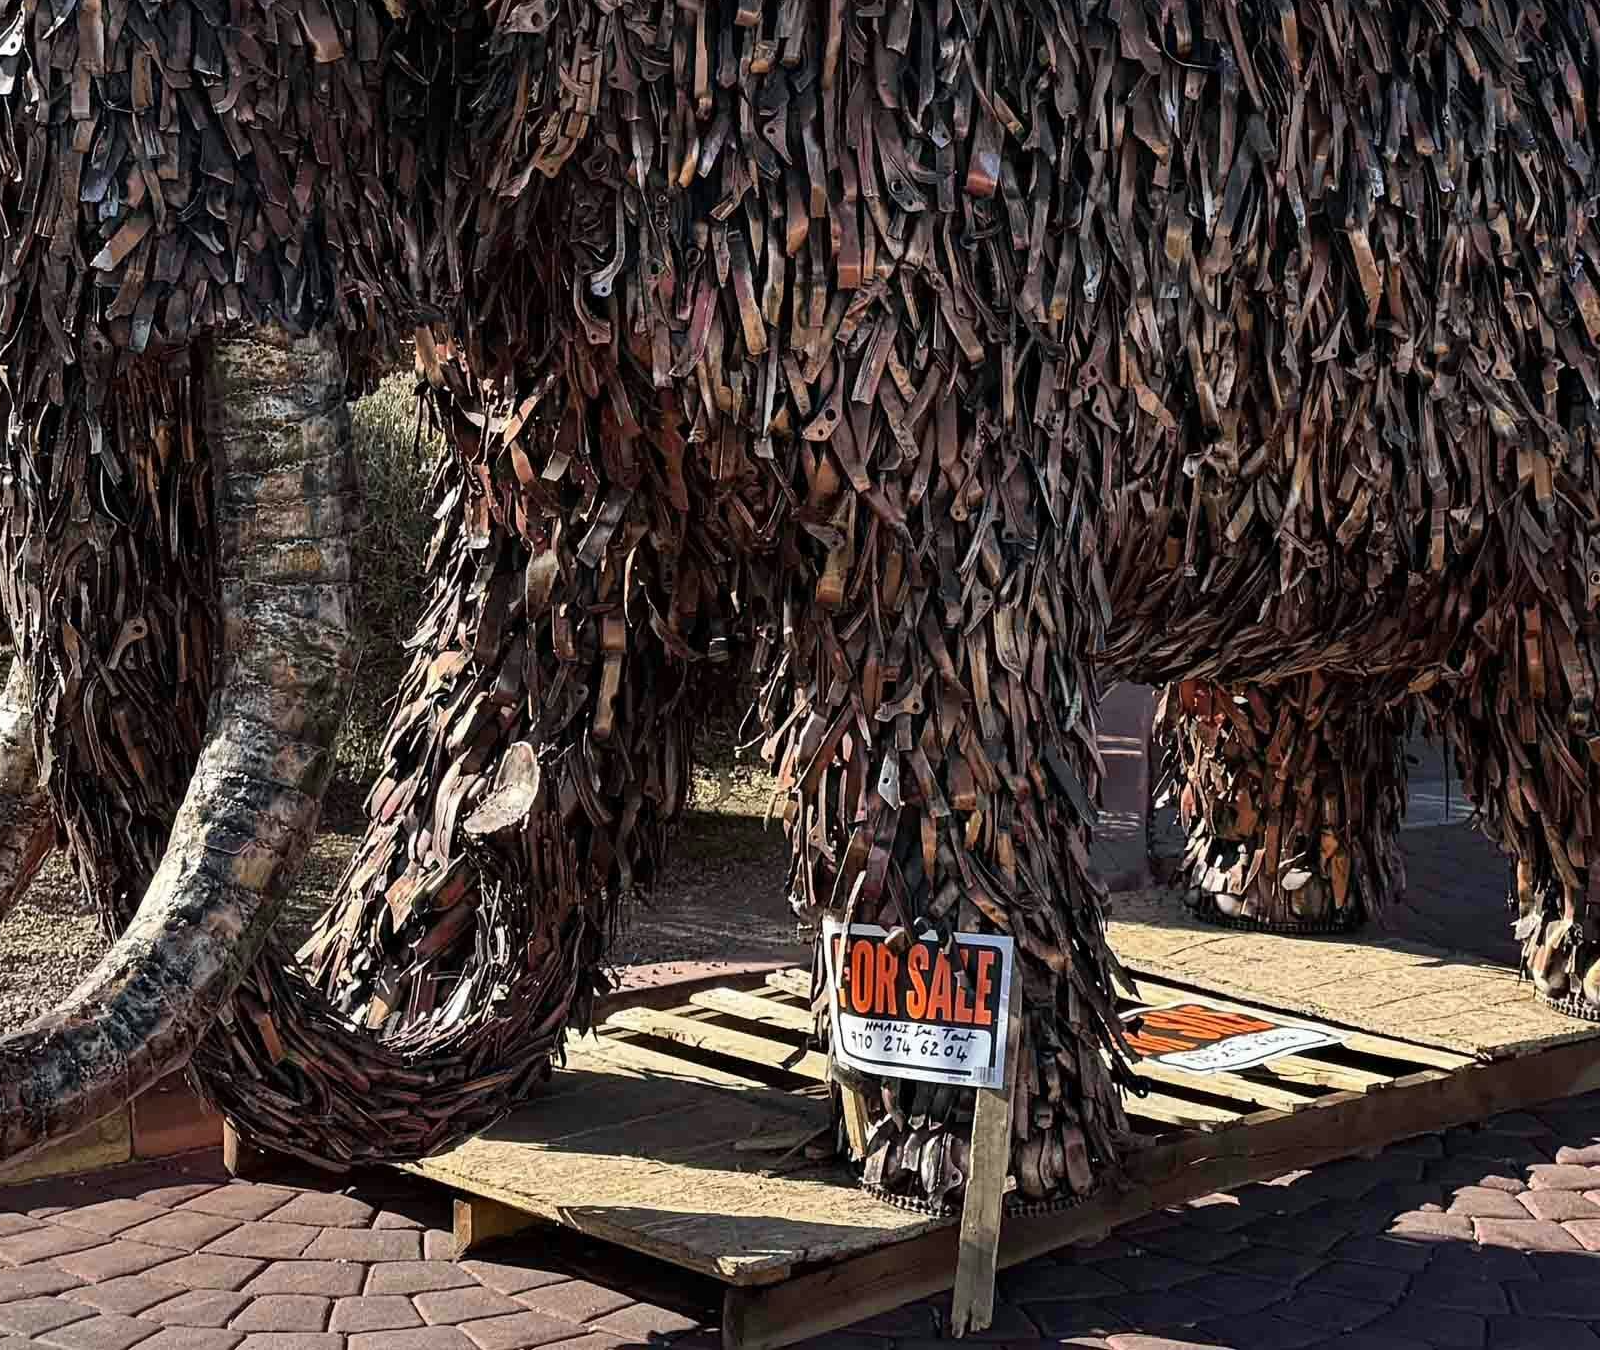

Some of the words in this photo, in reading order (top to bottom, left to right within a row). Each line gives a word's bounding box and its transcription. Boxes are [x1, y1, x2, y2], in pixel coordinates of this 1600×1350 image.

[905, 942, 997, 1026] SALE
[883, 1035, 912, 1057] 274
[920, 1039, 969, 1064] 6204
